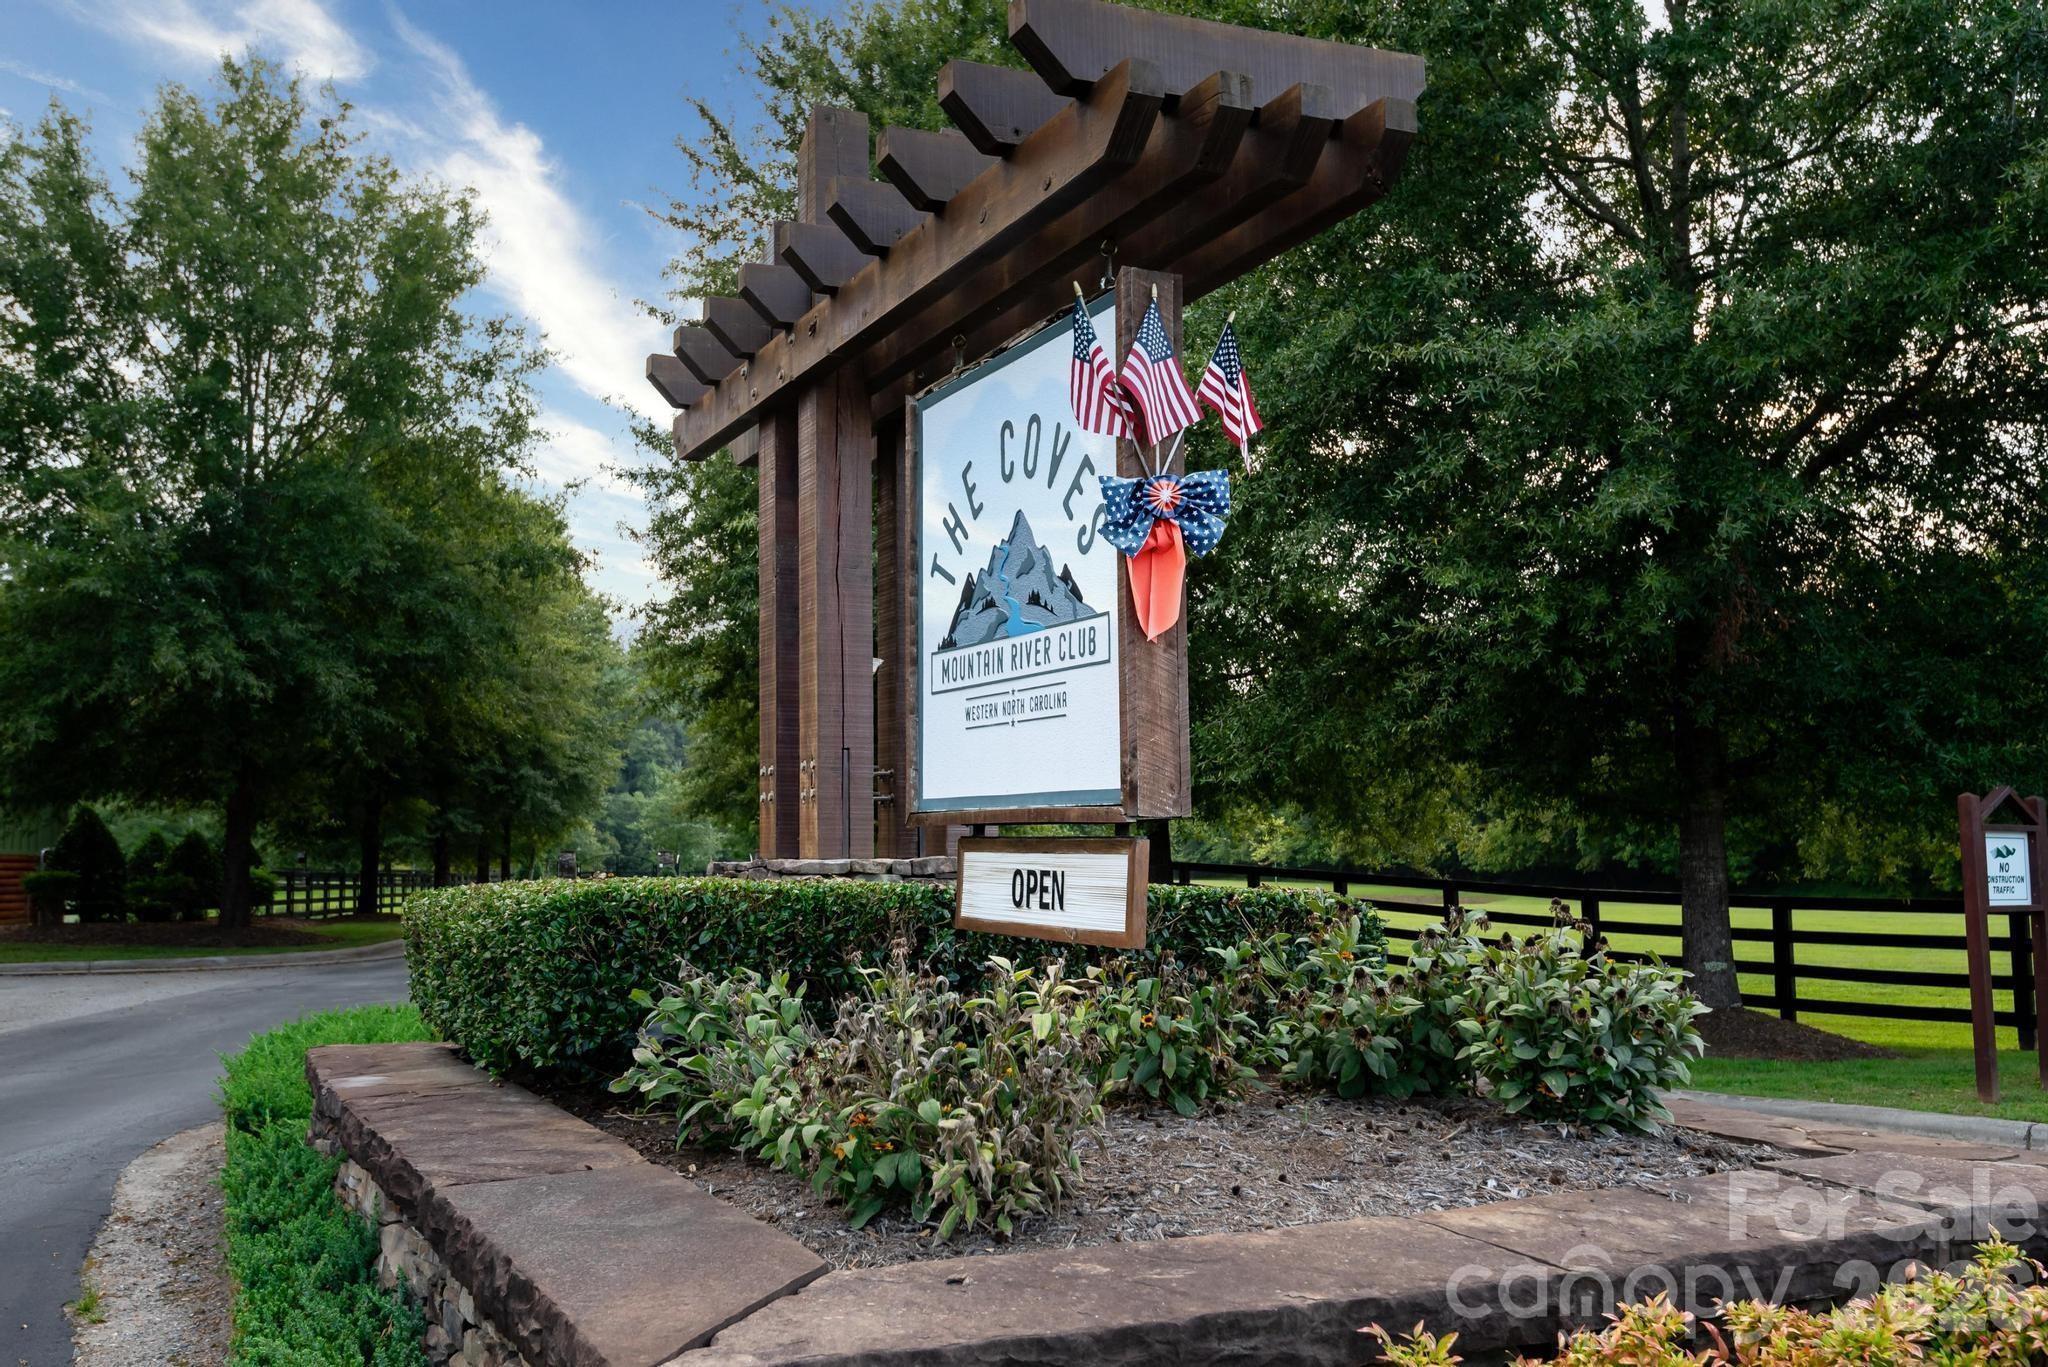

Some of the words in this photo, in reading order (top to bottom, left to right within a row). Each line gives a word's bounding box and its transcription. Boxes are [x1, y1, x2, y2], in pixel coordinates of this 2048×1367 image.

[931, 461, 984, 585] THE
[1001, 414, 1108, 555] COVES
[941, 646, 1004, 684] MOUNTAIN
[1010, 636, 1051, 671] RIVER
[1059, 626, 1097, 661] CLUB
[965, 701, 998, 722] WESTERN
[1002, 697, 1025, 715] NORTH
[1029, 691, 1067, 713] CAROLINA
[1988, 875, 2025, 884] ONSTRUCTION
[1999, 862, 2010, 873] NO
[1012, 868, 1065, 911] OPEN
[1993, 886, 2015, 894] TRAFFIC
